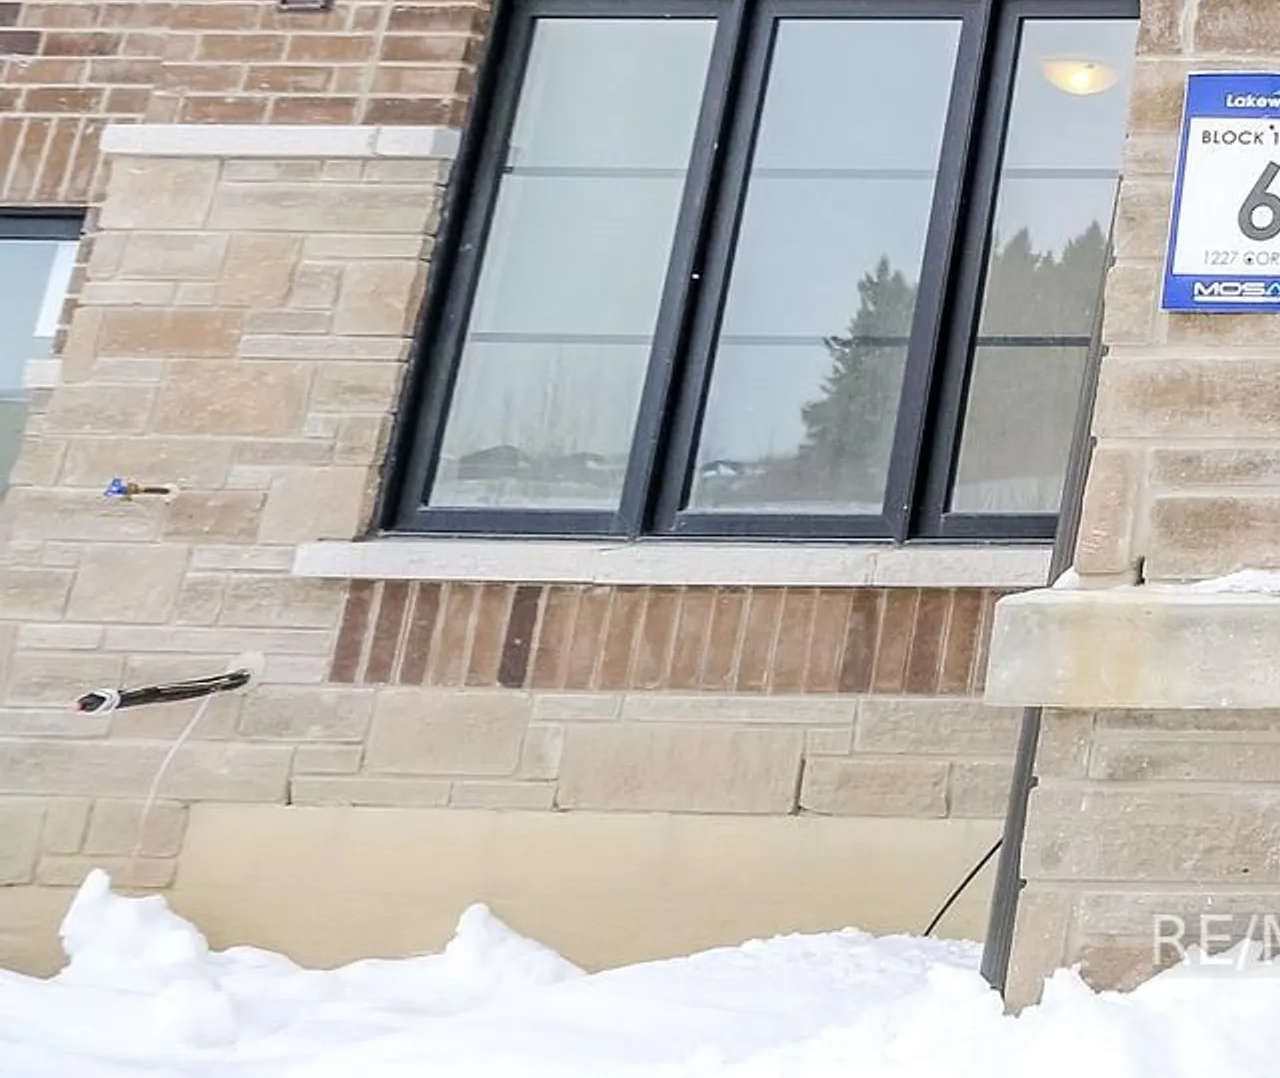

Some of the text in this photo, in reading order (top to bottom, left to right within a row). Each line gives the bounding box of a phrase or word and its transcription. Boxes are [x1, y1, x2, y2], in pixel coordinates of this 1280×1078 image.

[1202, 130, 1264, 144] BLOCK
[1273, 131, 1279, 145] 1
[1204, 250, 1239, 265] 1227
